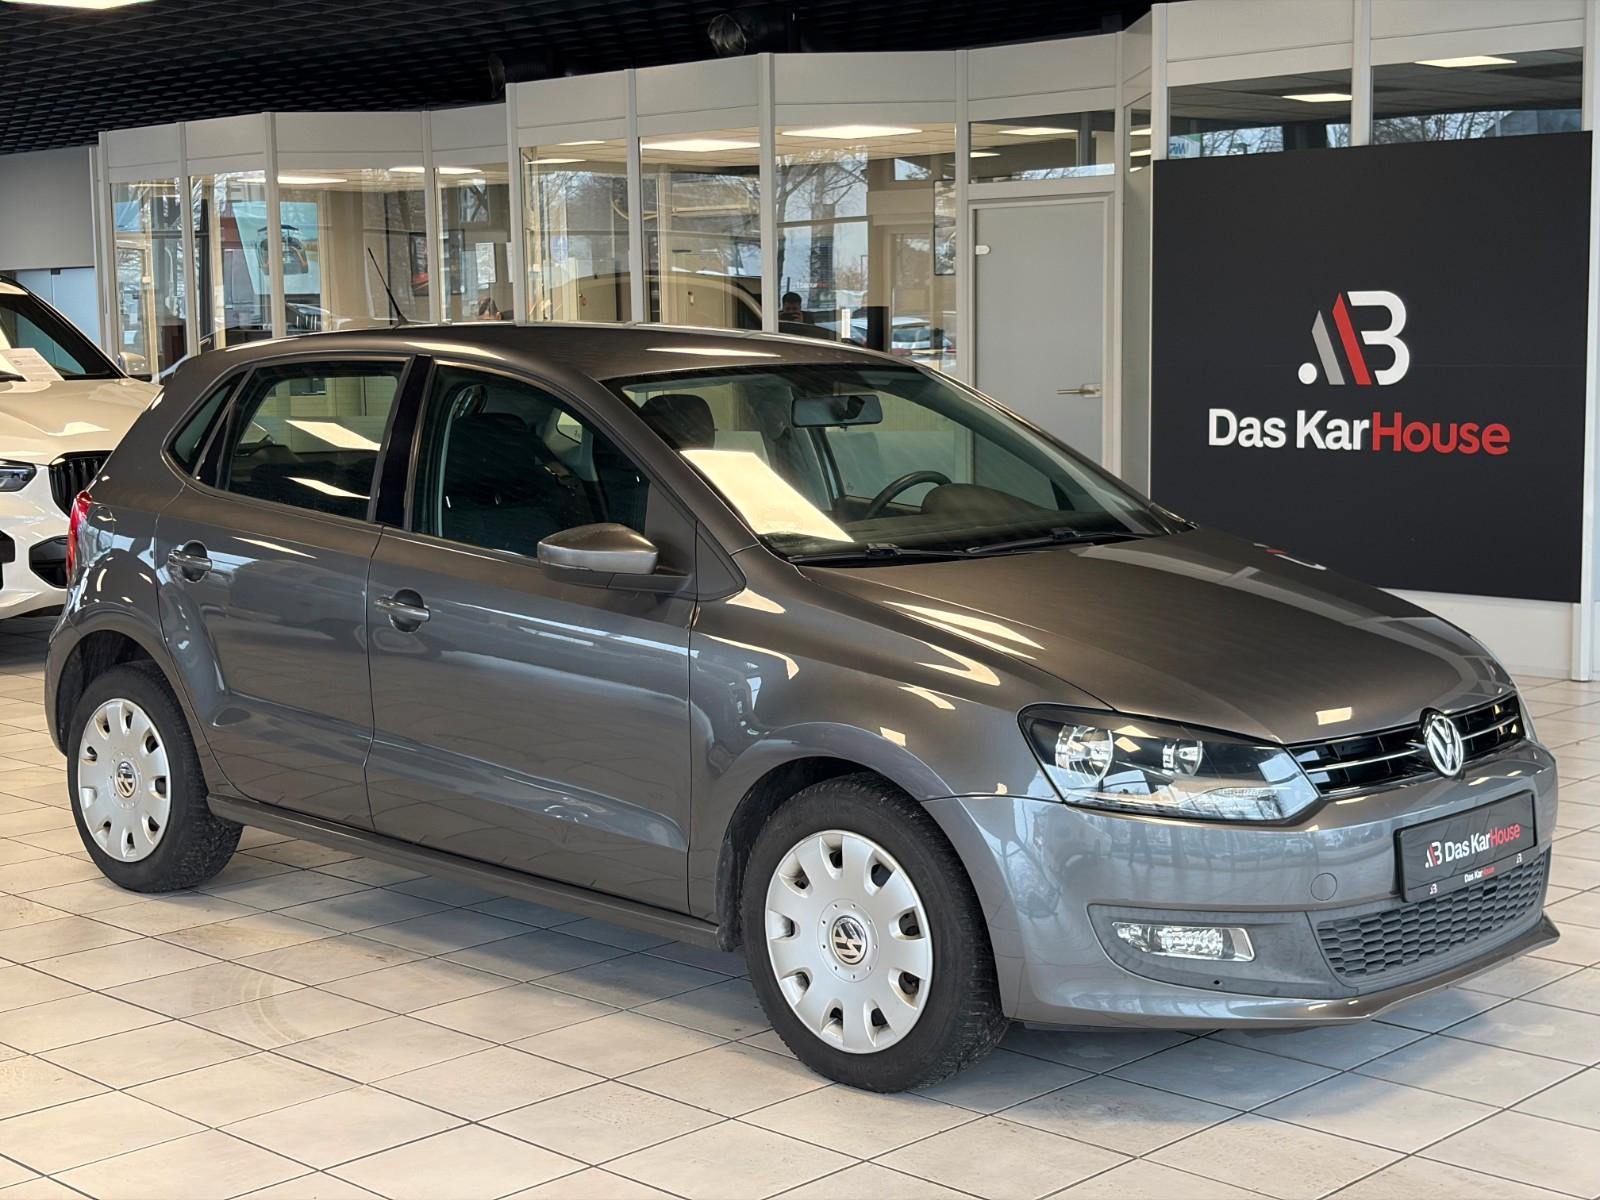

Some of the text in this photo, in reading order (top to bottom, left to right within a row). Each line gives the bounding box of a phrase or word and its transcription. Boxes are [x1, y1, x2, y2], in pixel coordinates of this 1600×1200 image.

[1208, 408, 1511, 456] Das KarHouse
[1445, 840, 1470, 862] Das
[1470, 823, 1521, 854] KarHouse
